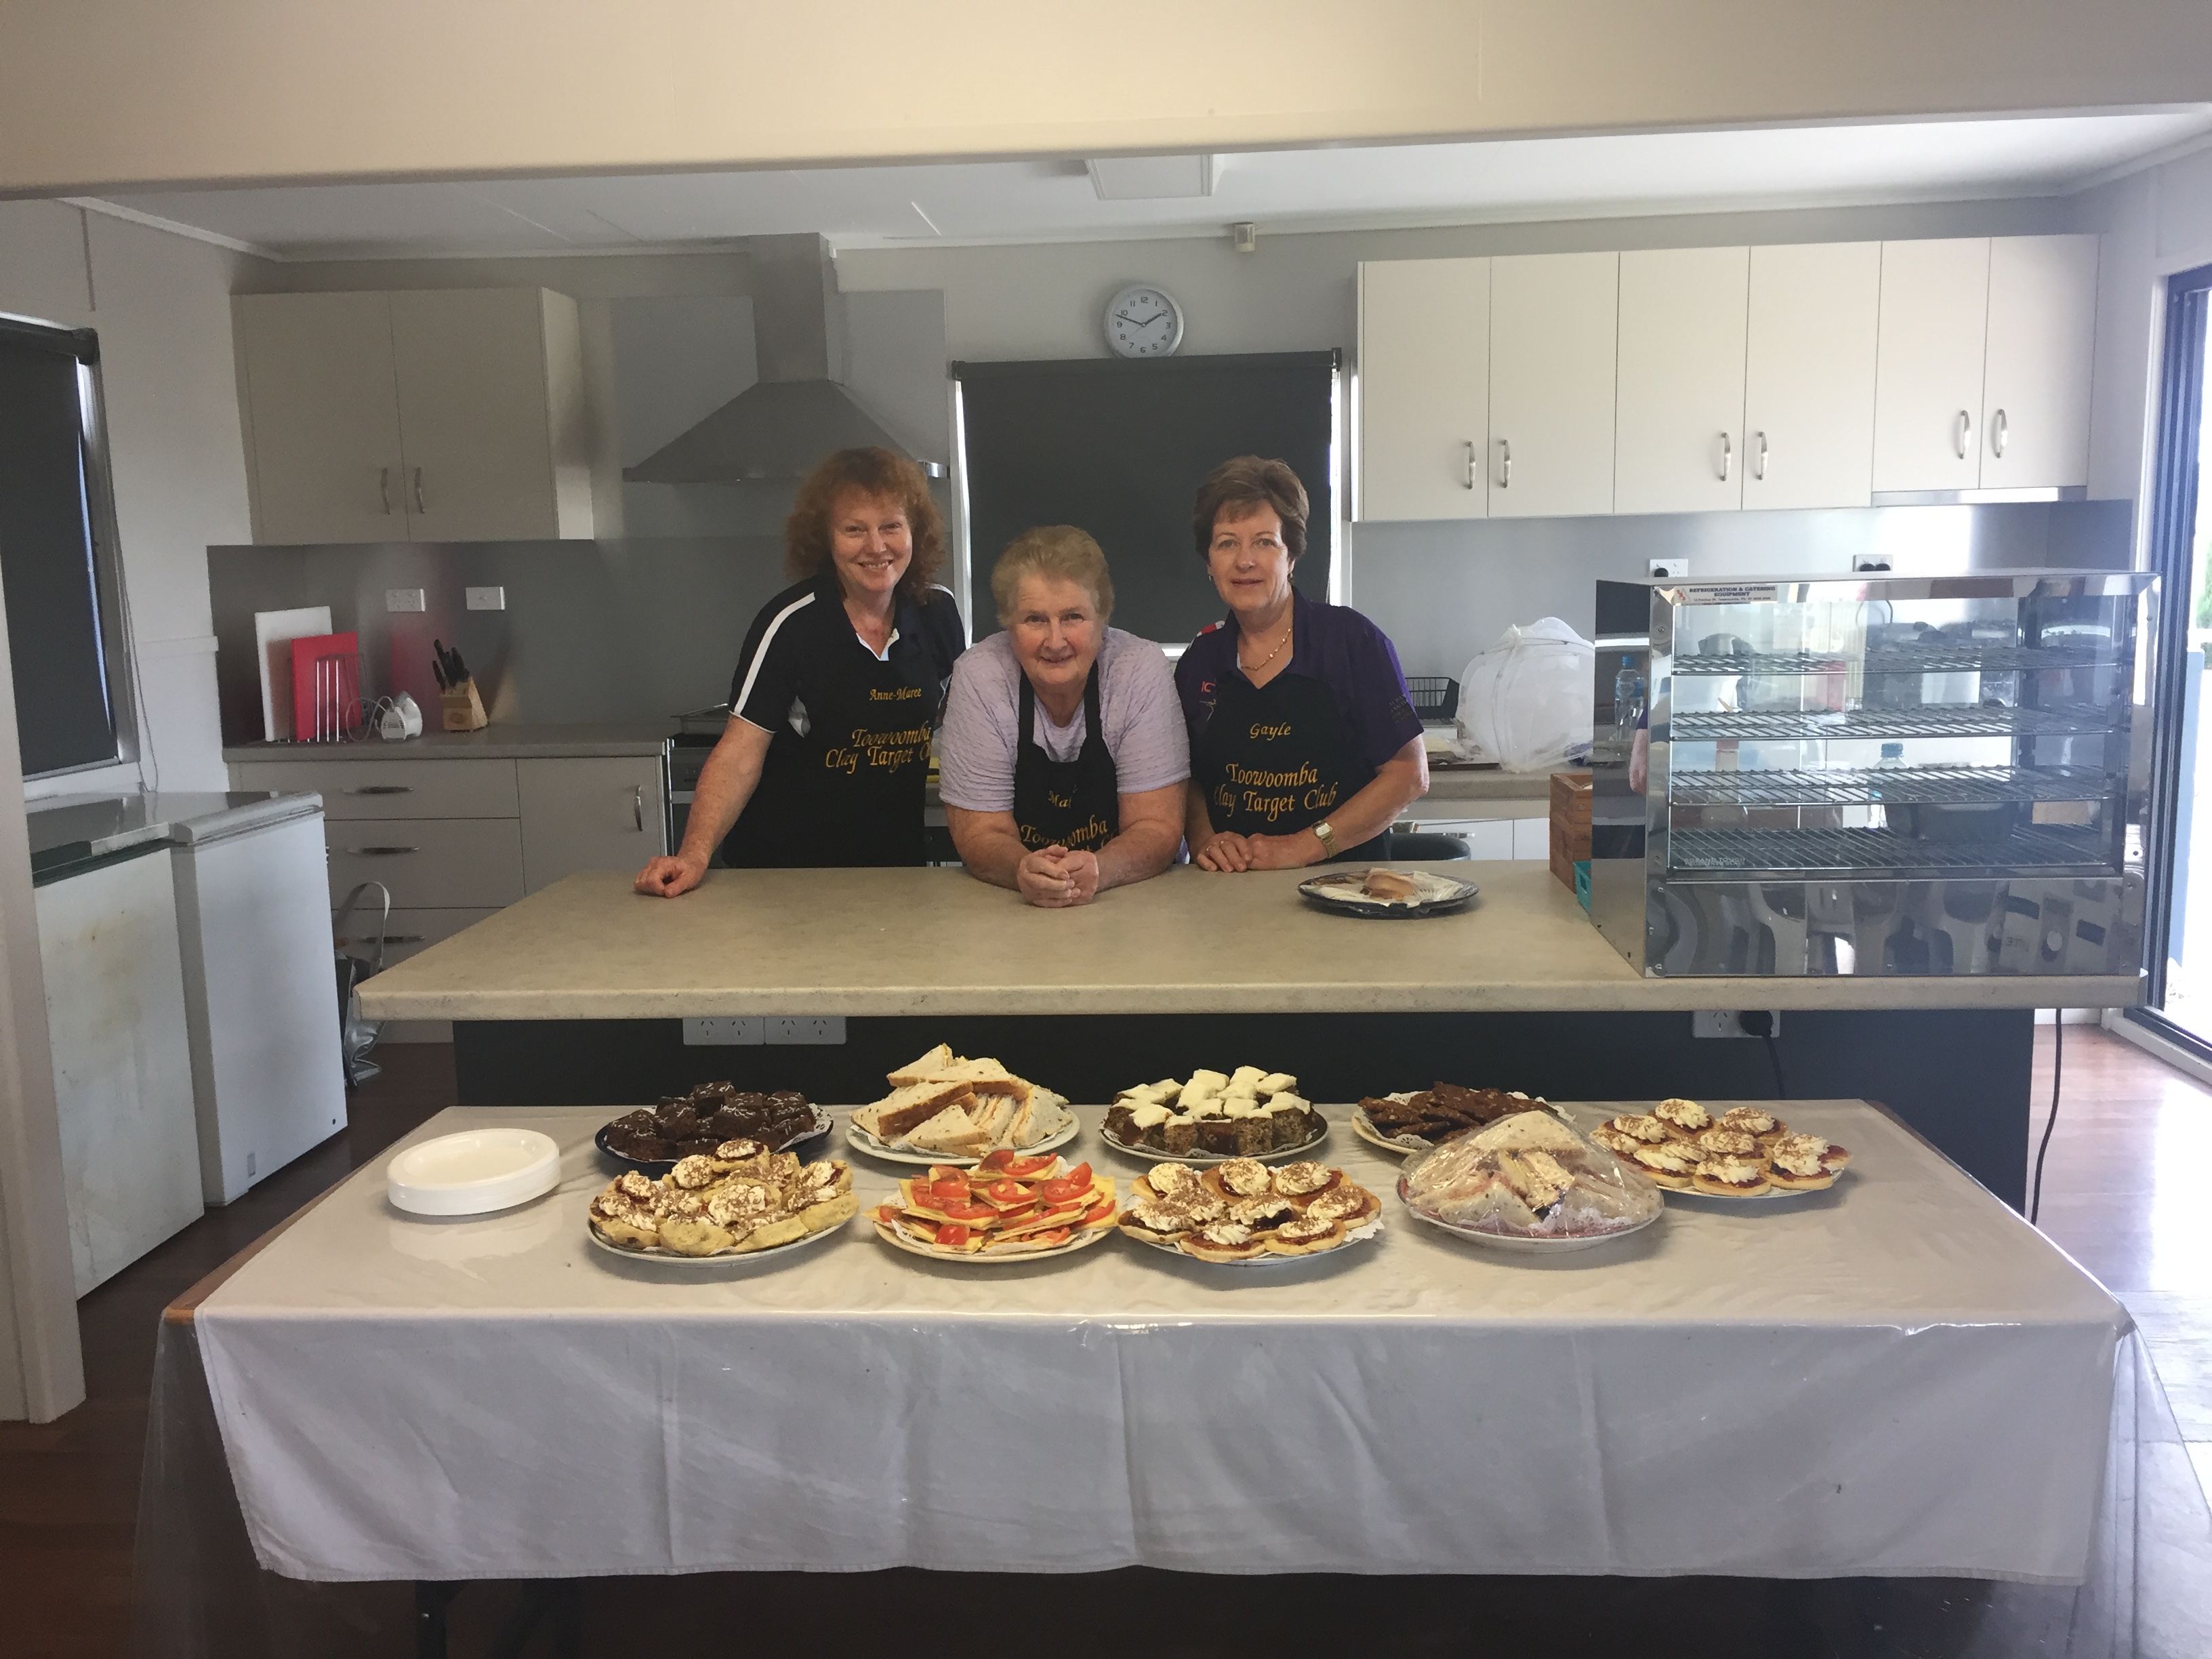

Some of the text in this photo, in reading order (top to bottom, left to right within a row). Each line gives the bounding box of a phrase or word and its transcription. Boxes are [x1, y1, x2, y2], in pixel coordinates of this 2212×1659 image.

[869, 687, 922, 701] Anne-Maree
[1250, 722, 1292, 741] Gayle
[825, 748, 859, 775] Clay
[867, 746, 914, 773] Target
[1225, 761, 1318, 787] Toowoomba
[1243, 790, 1295, 822] Target
[1304, 781, 1338, 810] Club
